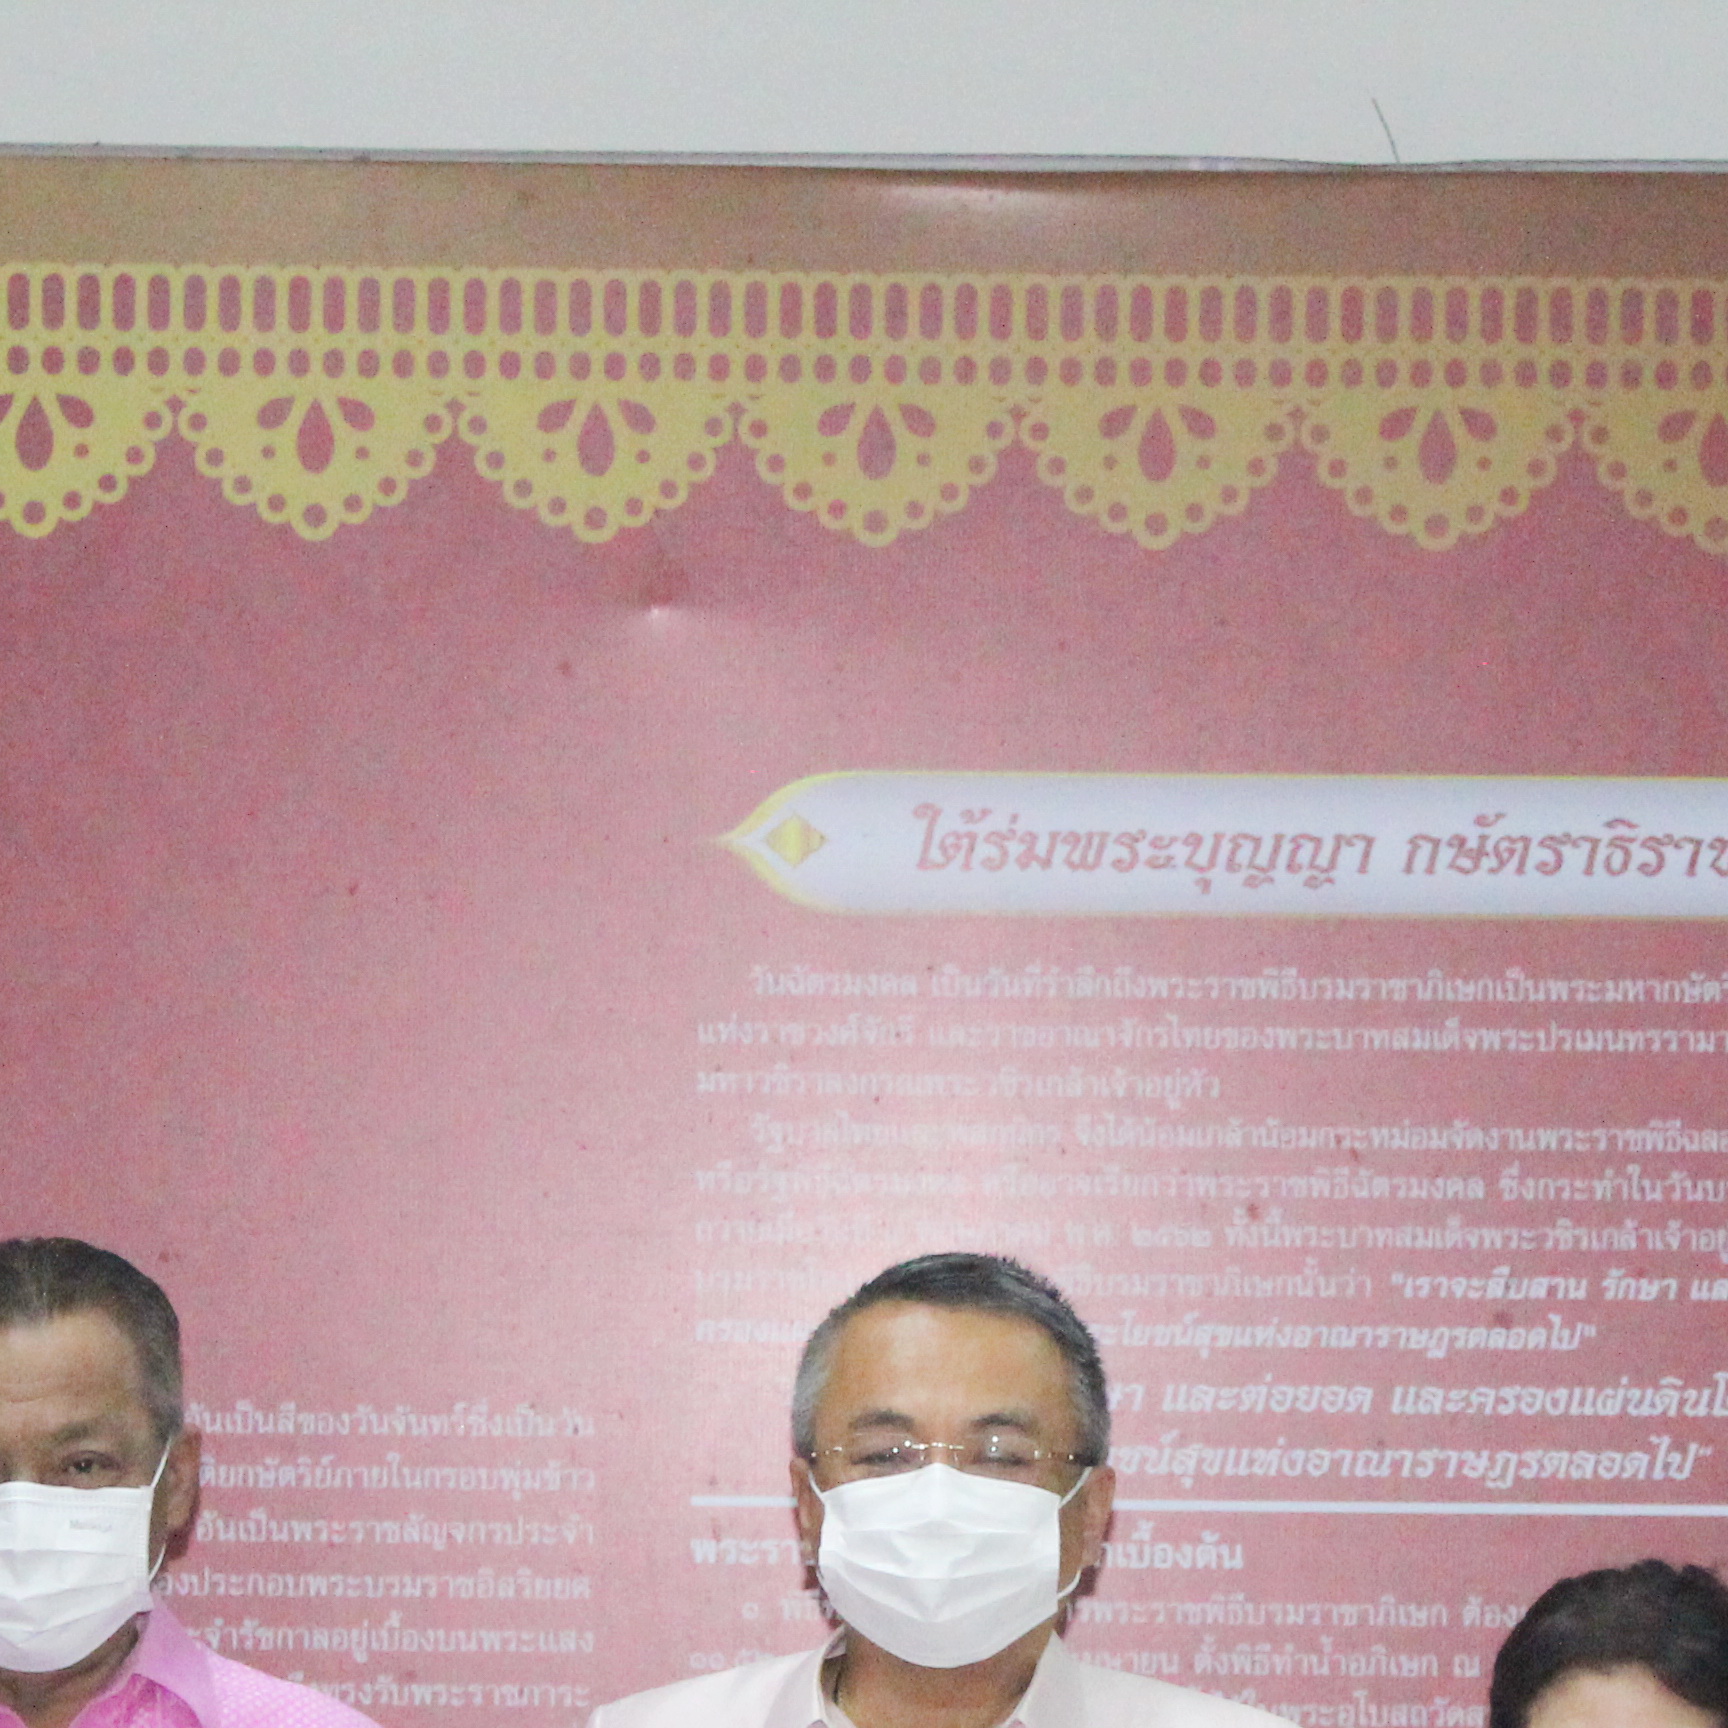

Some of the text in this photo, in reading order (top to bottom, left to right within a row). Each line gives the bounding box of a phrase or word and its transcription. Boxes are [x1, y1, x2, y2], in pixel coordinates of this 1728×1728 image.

[908, 801, 1378, 896] ใต้ร่มพระบุญญา
[1602, 1268, 1679, 1301] รักษา
[1162, 1369, 1374, 1413] และต่อยอด
[1453, 1655, 1481, 1677] ณ
